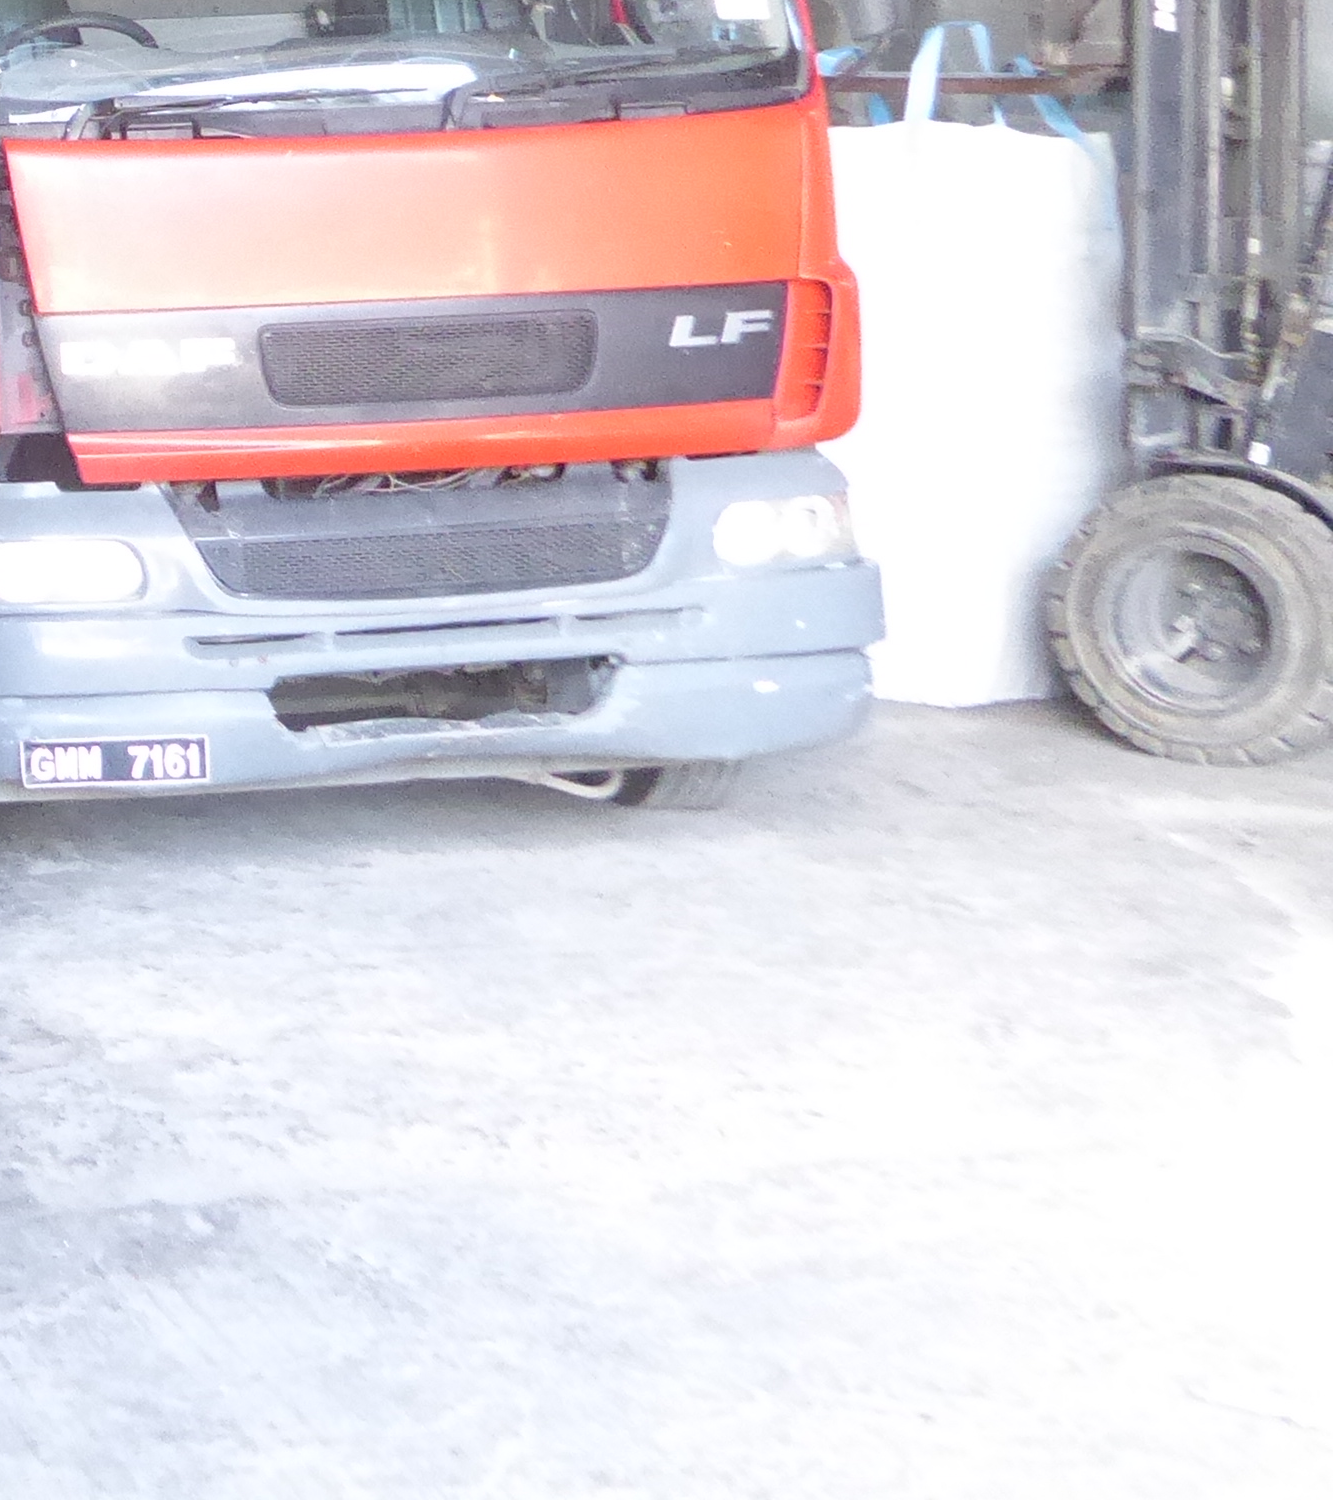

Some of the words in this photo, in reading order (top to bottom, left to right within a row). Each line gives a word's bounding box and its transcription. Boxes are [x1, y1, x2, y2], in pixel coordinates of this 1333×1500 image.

[669, 309, 774, 347] LF
[30, 745, 103, 781] GMM
[127, 742, 201, 779] 7161
